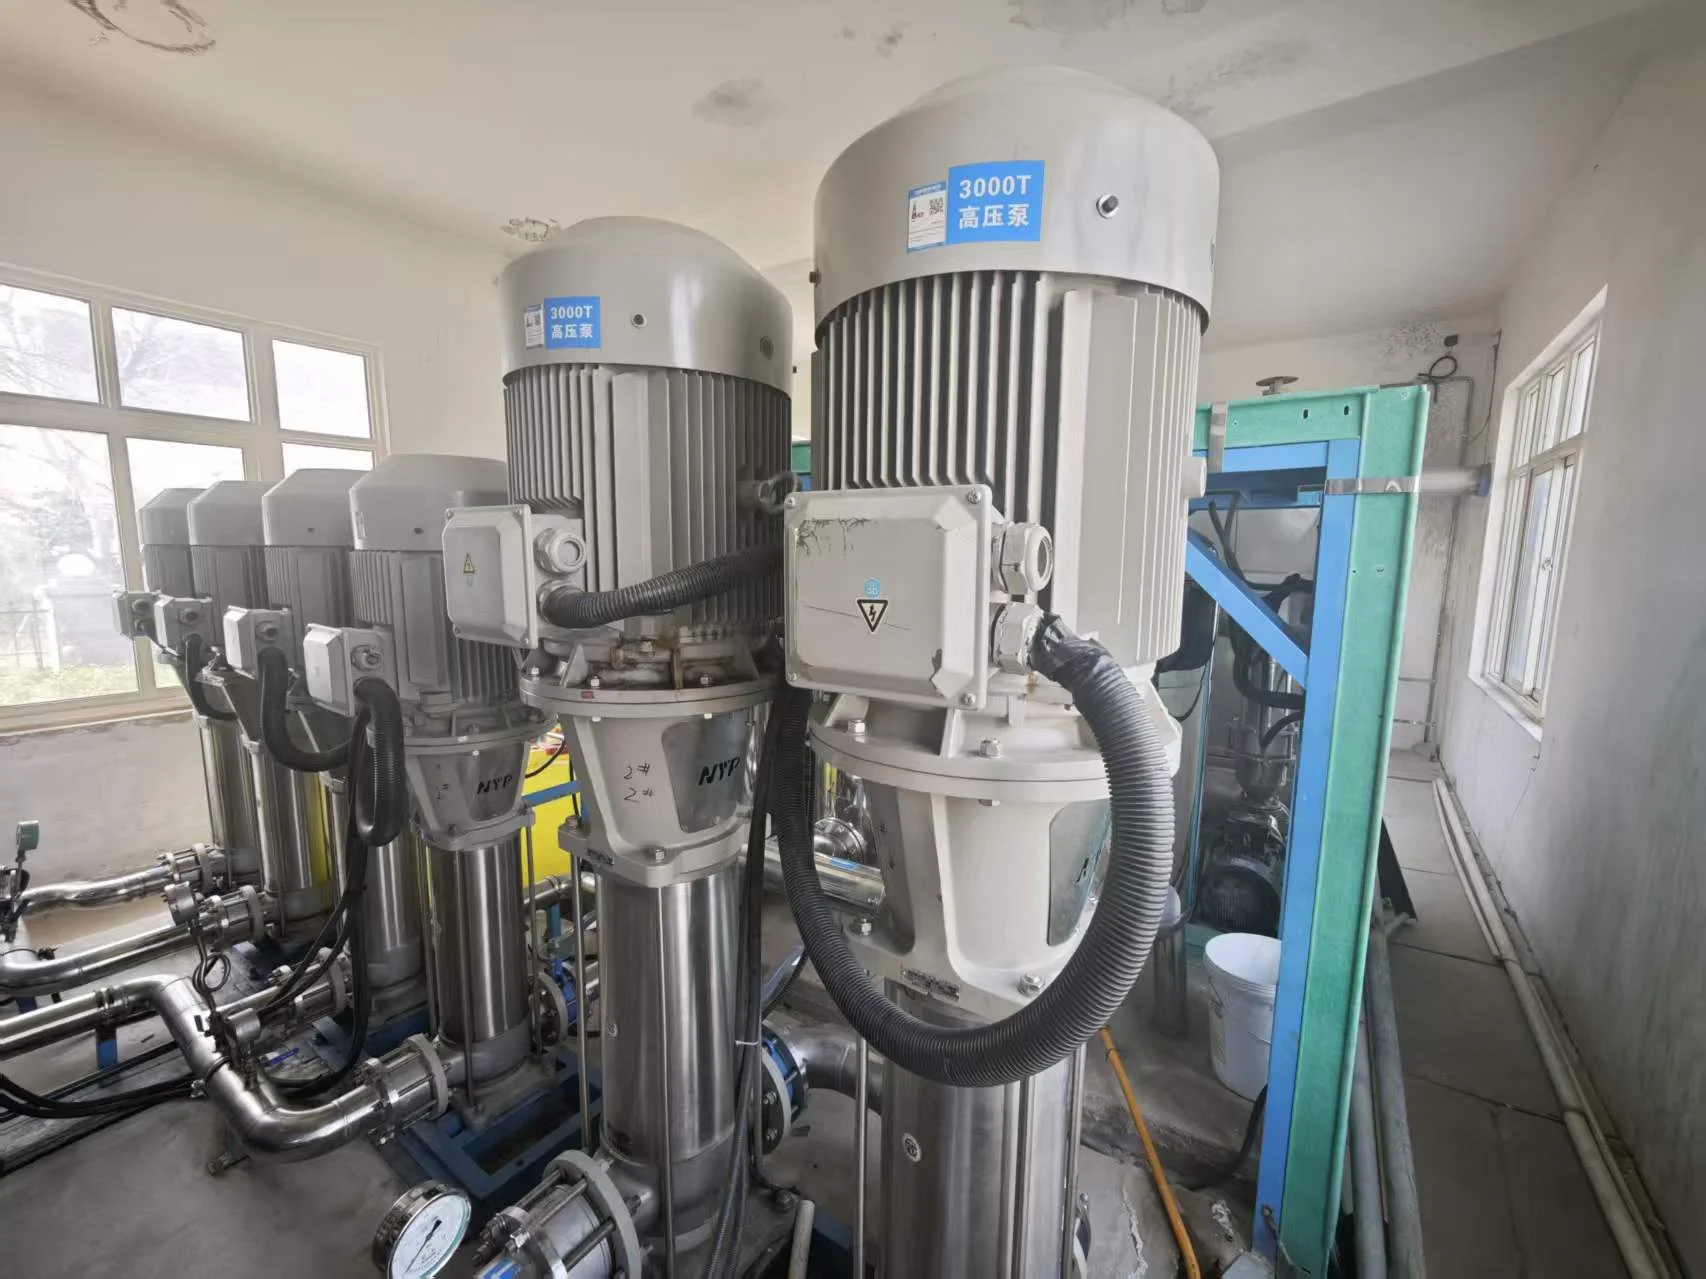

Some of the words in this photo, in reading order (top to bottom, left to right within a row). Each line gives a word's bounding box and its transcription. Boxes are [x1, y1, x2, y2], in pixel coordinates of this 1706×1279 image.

[959, 174, 1032, 199] 3000T
[958, 203, 1030, 229] 高压泵
[550, 305, 593, 320] 3000T
[551, 323, 594, 339] 高压泵
[698, 756, 741, 786] NYP
